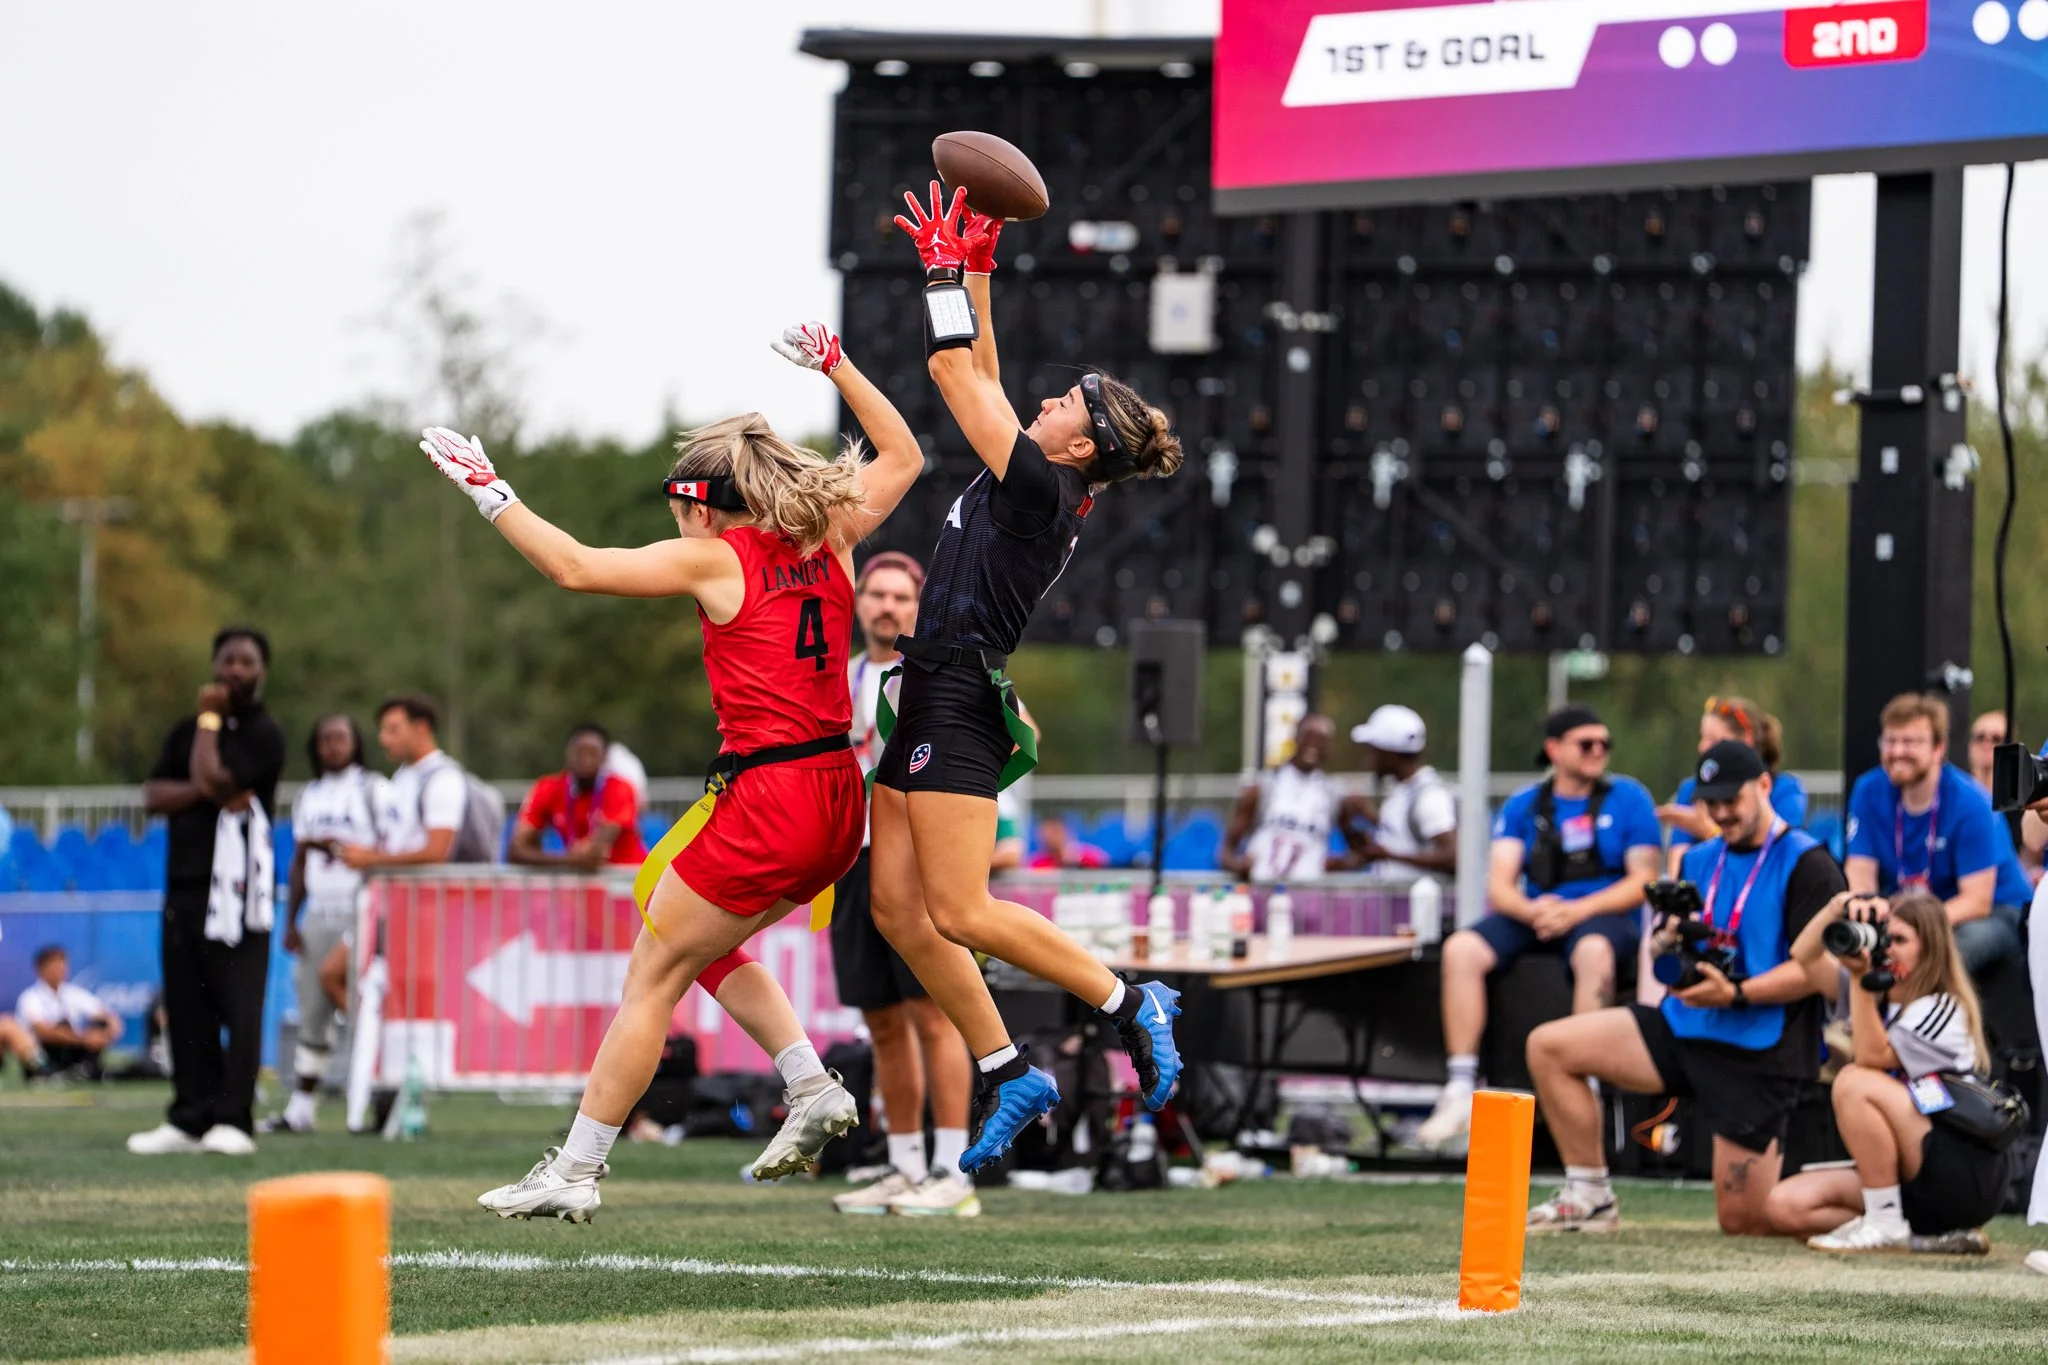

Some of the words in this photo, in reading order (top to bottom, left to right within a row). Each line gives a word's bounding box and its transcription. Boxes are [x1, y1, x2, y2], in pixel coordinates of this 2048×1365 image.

[1324, 42, 1390, 73] 1ST
[1405, 40, 1427, 69] &
[1441, 33, 1545, 66] GOAL
[1812, 16, 1898, 58] 2ND
[794, 596, 829, 673] 4
